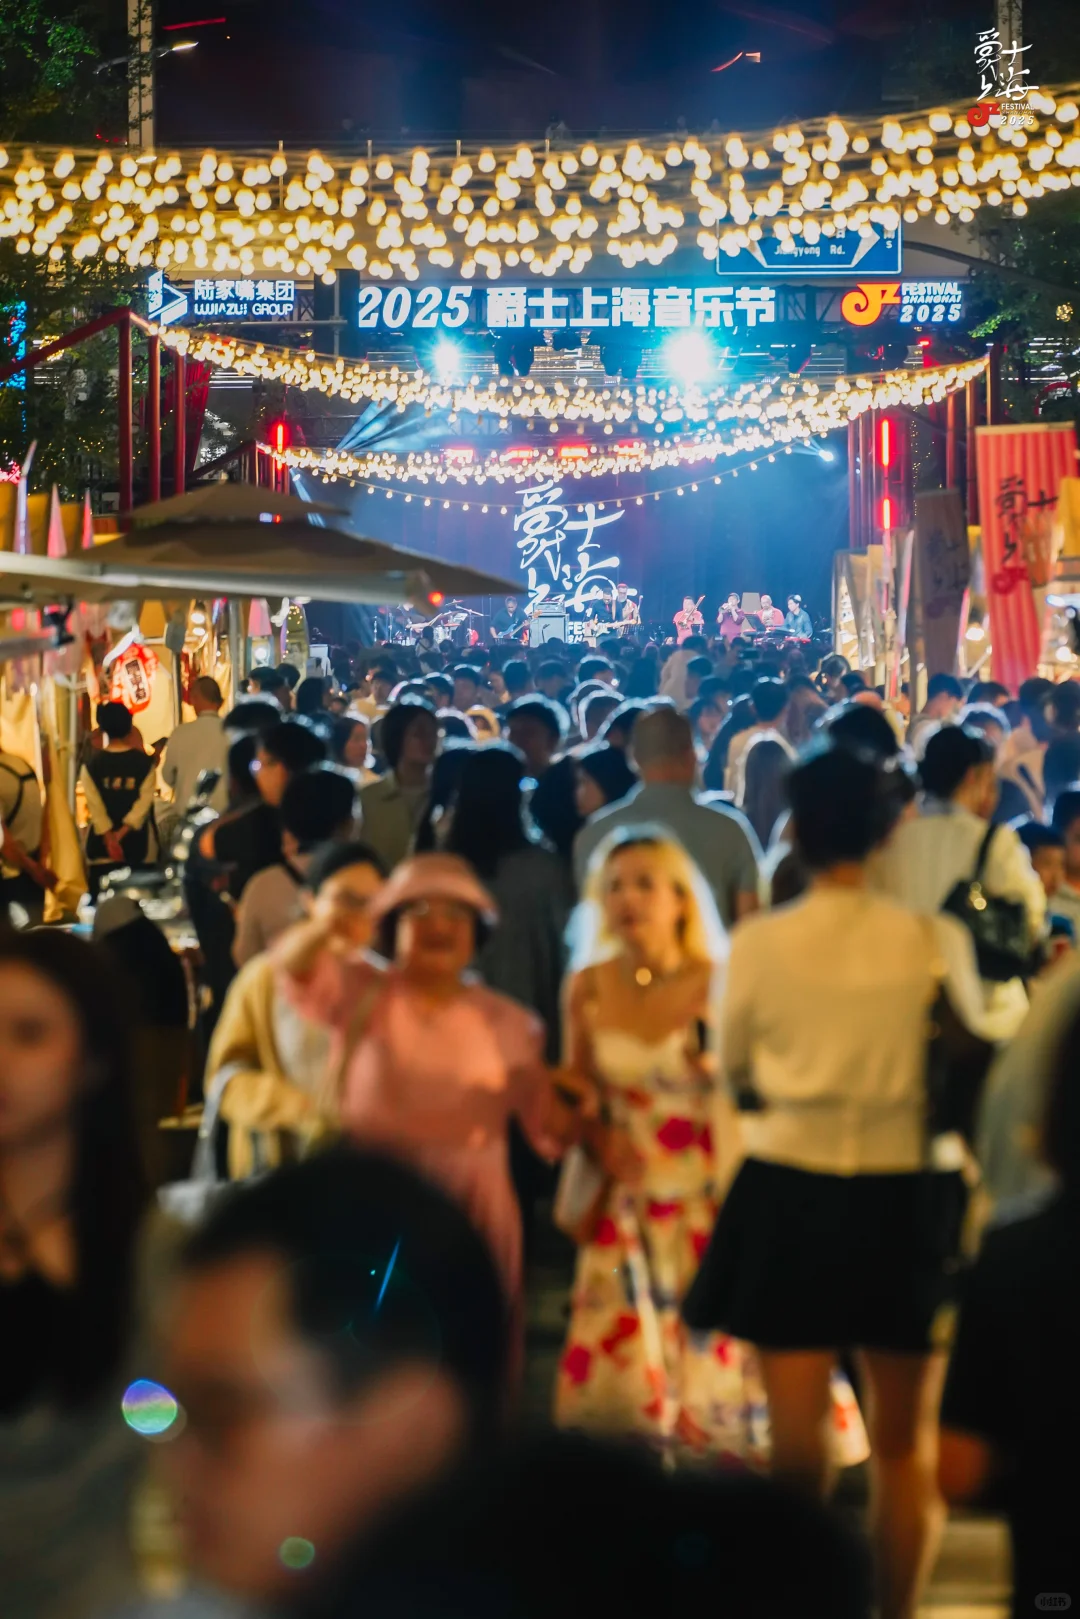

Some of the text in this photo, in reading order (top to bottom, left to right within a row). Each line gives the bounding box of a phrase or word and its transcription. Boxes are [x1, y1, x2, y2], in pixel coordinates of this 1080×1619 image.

[830, 244, 846, 255] Rd.
[194, 279, 294, 301] 陆家嘴集团
[901, 282, 962, 296] FESTIVAL
[358, 285, 776, 328] 2025 爵士上海音乐节
[902, 295, 962, 304] SHANGHAI
[252, 303, 294, 315] GROUP
[900, 304, 962, 322] 2025
